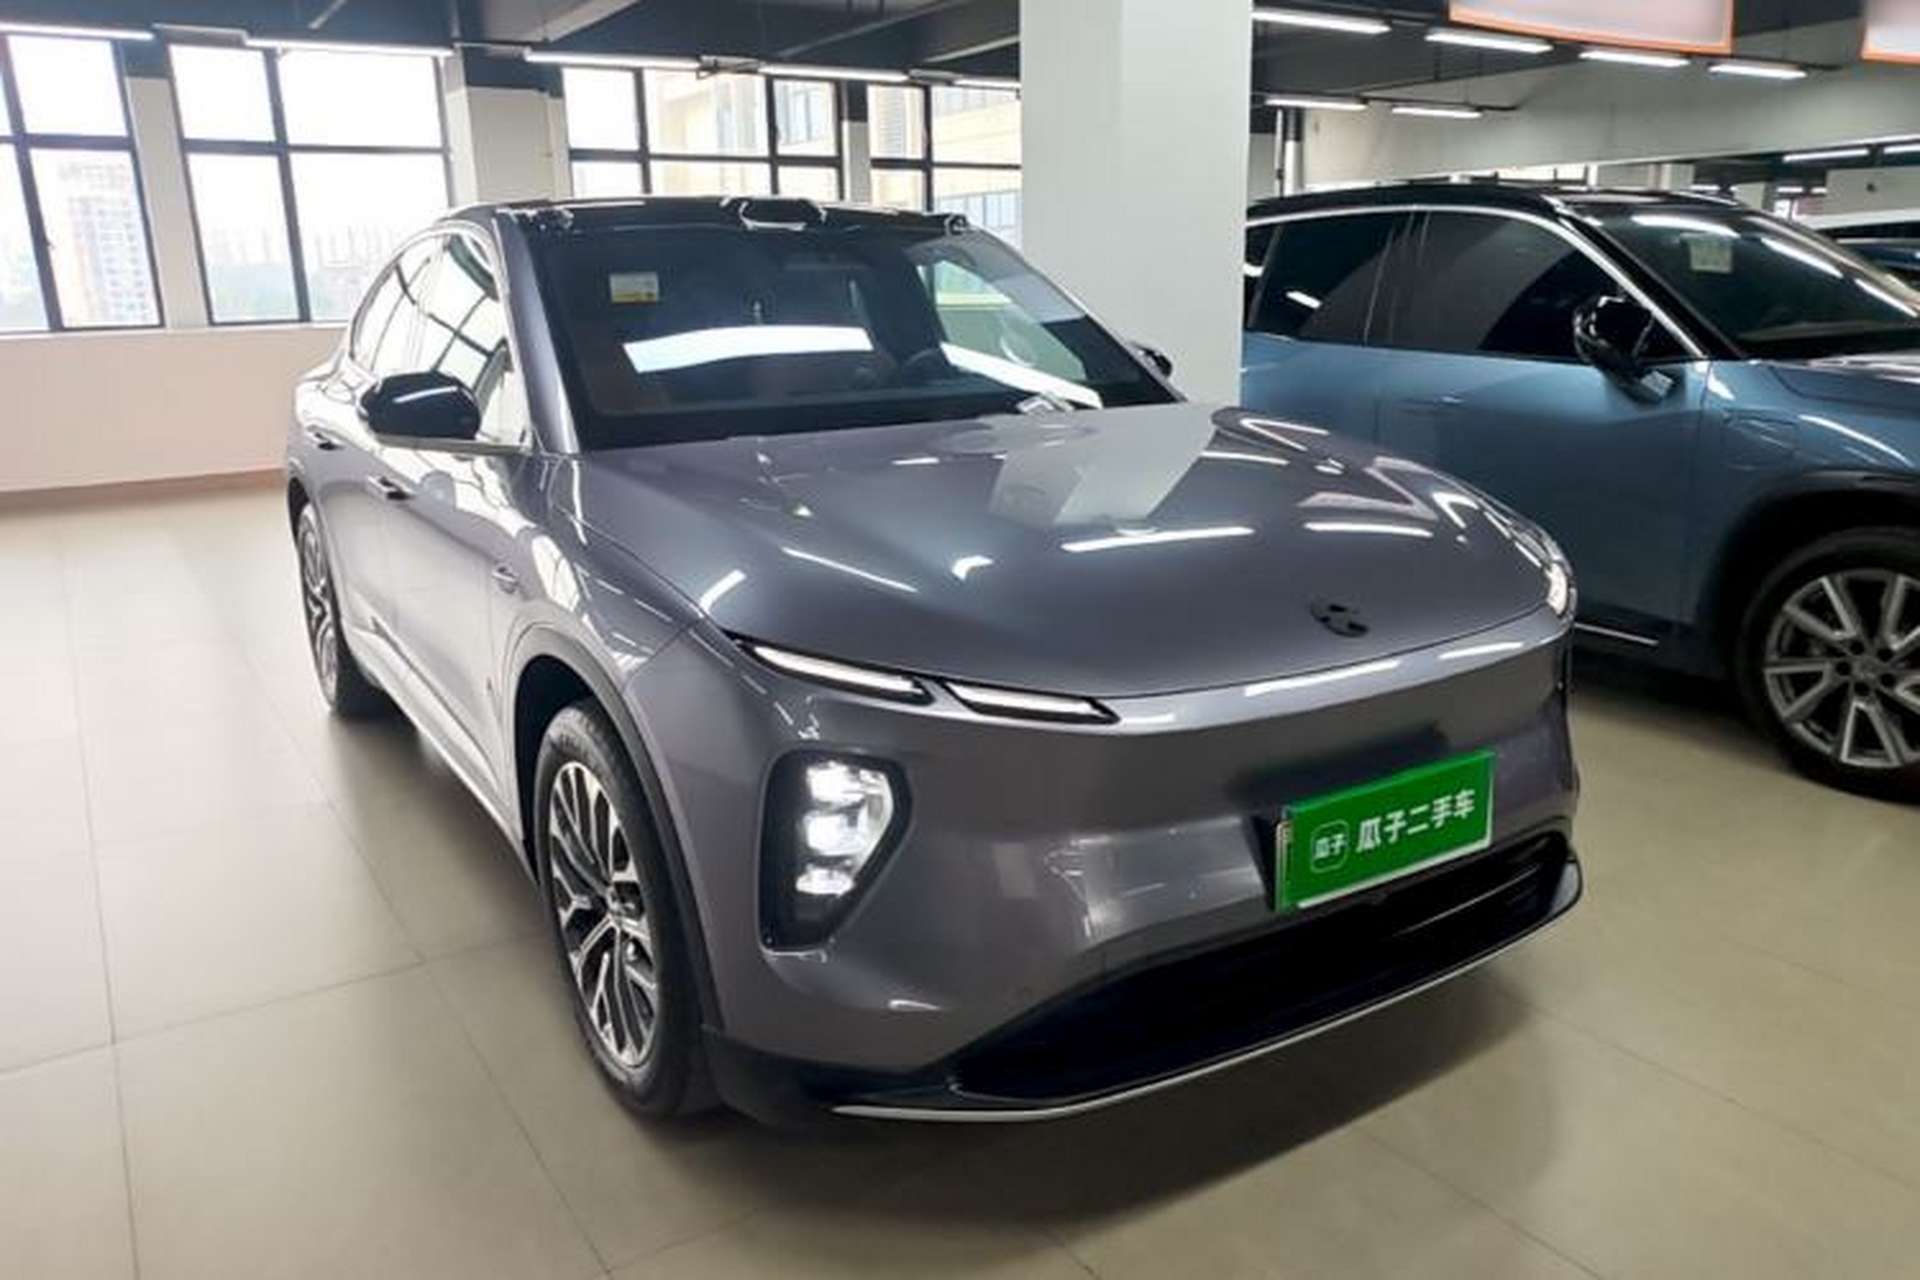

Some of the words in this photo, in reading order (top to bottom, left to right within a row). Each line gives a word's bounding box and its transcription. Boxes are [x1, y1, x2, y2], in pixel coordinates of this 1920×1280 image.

[1356, 789, 1475, 853] 瓜子二手车
[1314, 833, 1346, 860] 瓜子
